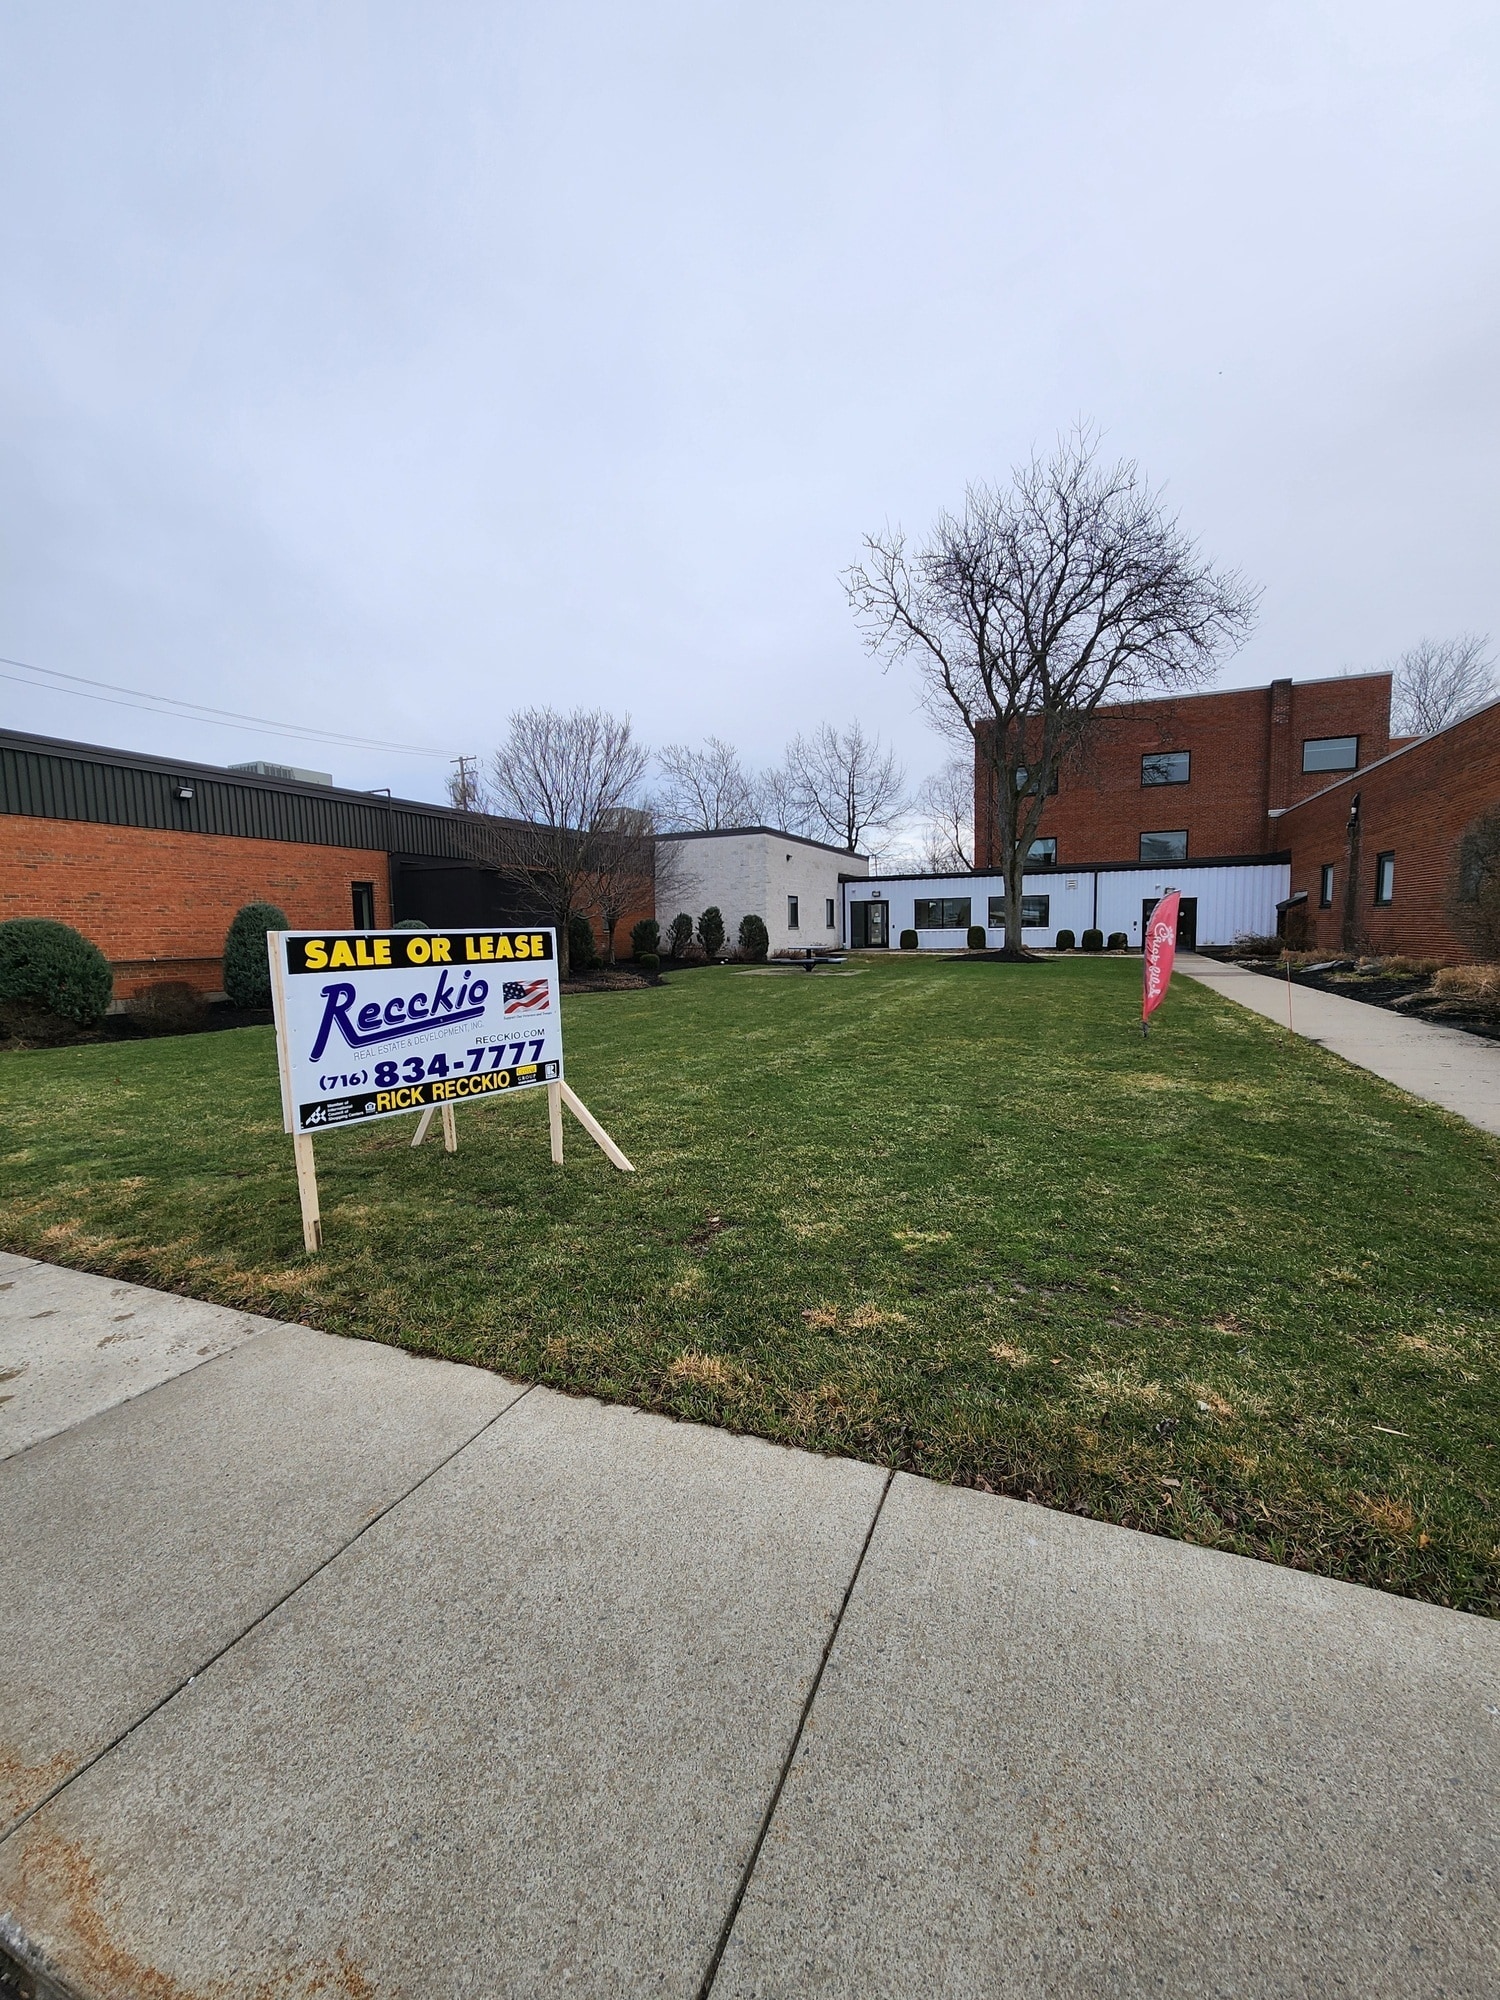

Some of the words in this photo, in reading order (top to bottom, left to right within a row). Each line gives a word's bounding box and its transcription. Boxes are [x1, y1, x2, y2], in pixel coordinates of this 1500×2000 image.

[304, 937, 392, 969] SALE
[406, 936, 452, 964] OR
[466, 934, 545, 961] LEASE
[309, 969, 489, 1062] Recckio
[353, 1049, 376, 1061] REAL
[378, 1040, 406, 1054] ESTATE
[407, 1038, 413, 1047] &
[414, 1024, 470, 1045] DEVELOPMENT,
[471, 1020, 485, 1030] INC.
[475, 1028, 545, 1045] RECCKIO.COM
[319, 1070, 368, 1091] (716)
[374, 1039, 545, 1088] 834-7777
[376, 1087, 425, 1112] RICK
[432, 1070, 510, 1101] RECCKIO
